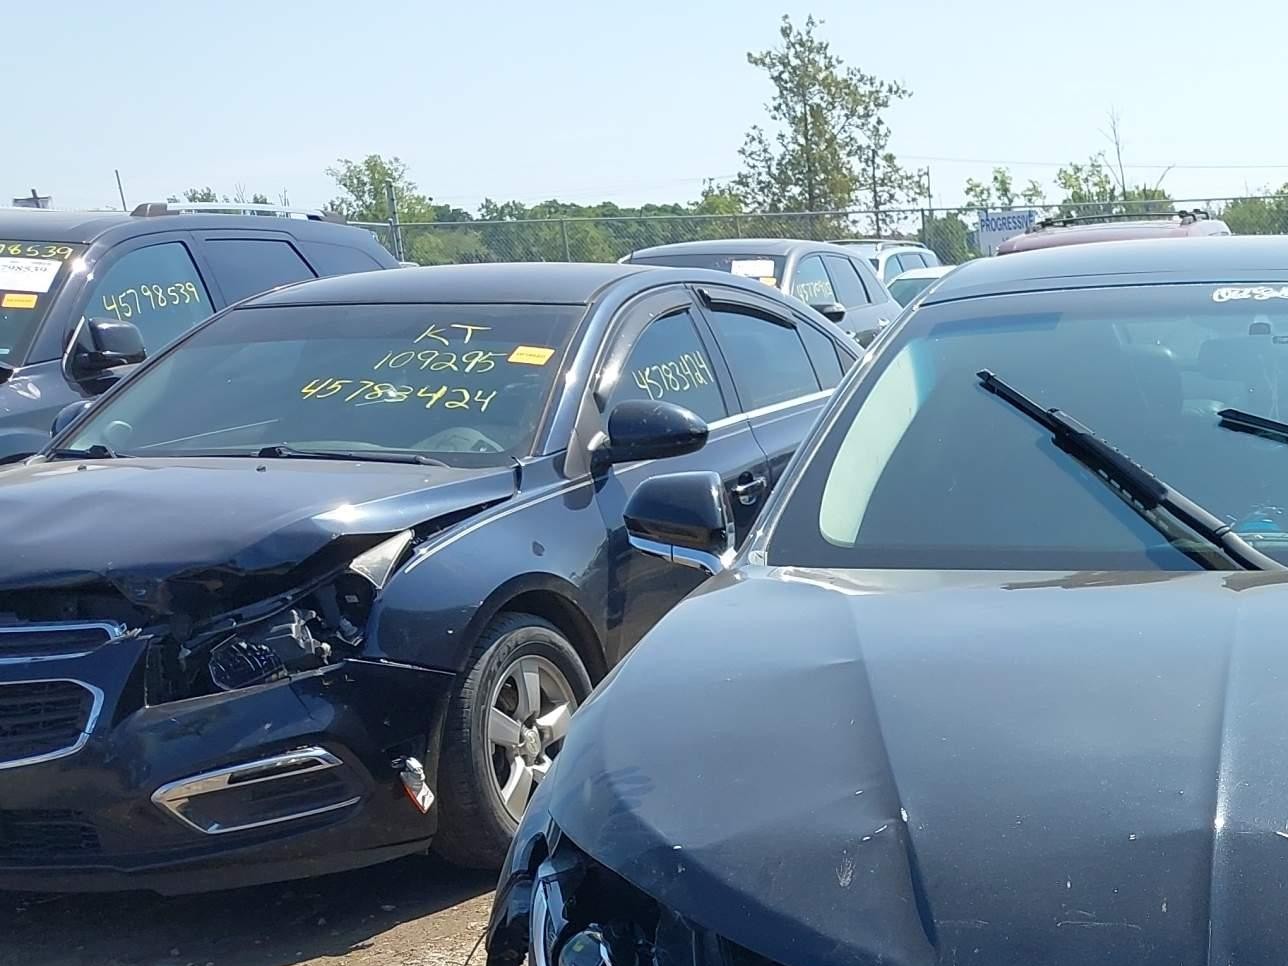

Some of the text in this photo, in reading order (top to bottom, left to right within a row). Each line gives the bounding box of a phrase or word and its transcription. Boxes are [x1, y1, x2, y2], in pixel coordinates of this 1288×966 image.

[102, 282, 200, 321] 45798539
[373, 349, 508, 373] 109295
[631, 350, 715, 401] 45783424
